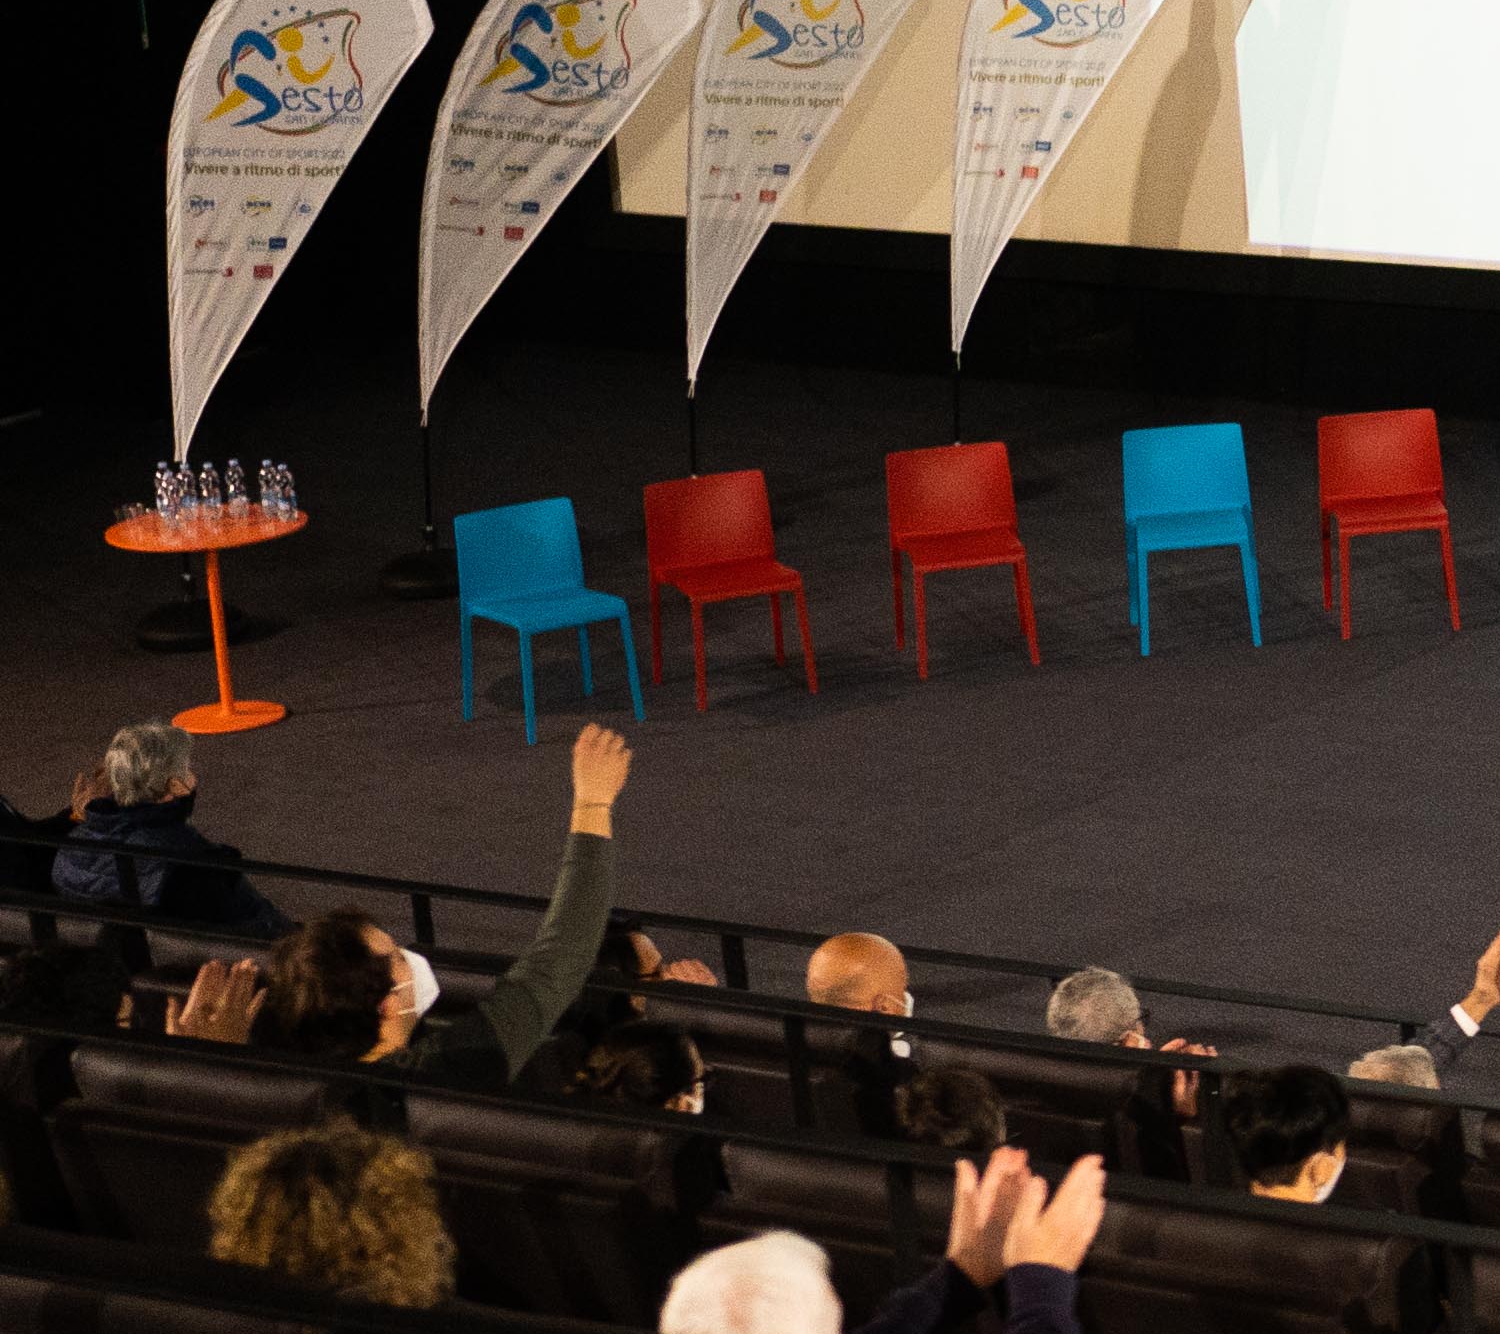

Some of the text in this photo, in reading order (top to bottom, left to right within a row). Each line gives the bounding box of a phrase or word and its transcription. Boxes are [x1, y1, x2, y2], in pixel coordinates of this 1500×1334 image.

[185, 163, 228, 175] Vivere
[244, 162, 283, 176] ritmo
[287, 163, 300, 175] di
